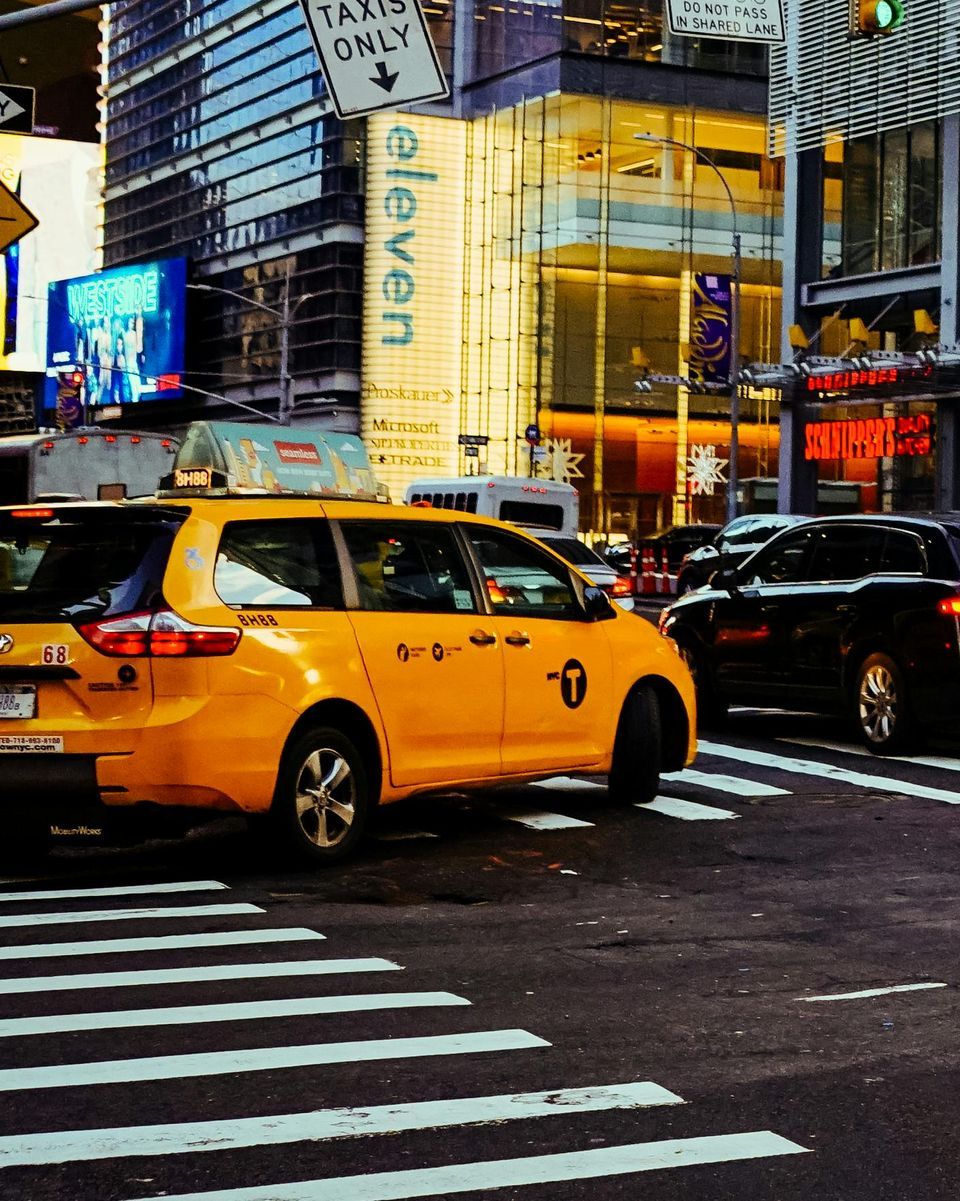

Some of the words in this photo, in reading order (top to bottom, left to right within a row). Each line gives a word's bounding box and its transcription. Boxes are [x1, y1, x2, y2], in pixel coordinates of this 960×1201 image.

[684, 2, 700, 13] DO
[705, 4, 728, 16] NOT
[735, 7, 768, 20] PASS
[676, 15, 688, 27] IN
[693, 18, 741, 33] SHARED
[746, 23, 778, 35] LANE
[333, 23, 409, 62] ONLY
[381, 125, 438, 346] eleven
[373, 418, 440, 434] Microsoft
[176, 470, 208, 488] 8H88
[43, 645, 67, 664] 68
